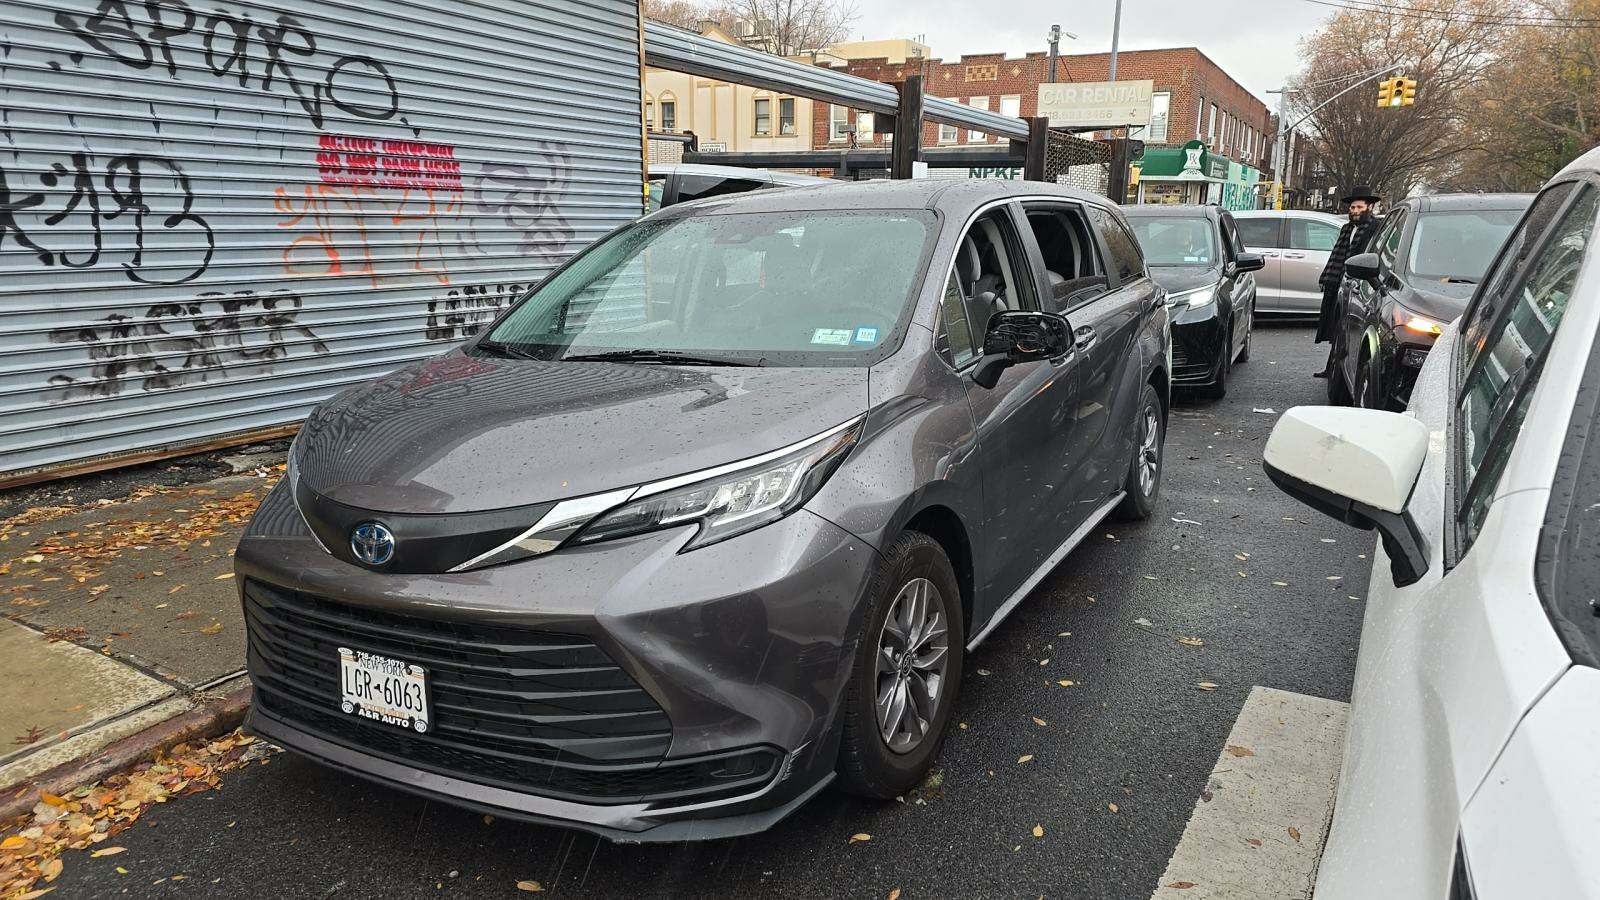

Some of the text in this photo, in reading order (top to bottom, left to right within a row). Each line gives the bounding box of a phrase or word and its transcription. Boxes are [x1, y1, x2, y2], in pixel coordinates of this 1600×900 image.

[1043, 84, 1150, 105] CAR RENTAL
[360, 658, 379, 671] NEW
[382, 662, 405, 678] YORK
[358, 708, 380, 721] A&R
[382, 715, 410, 728] AUTO
